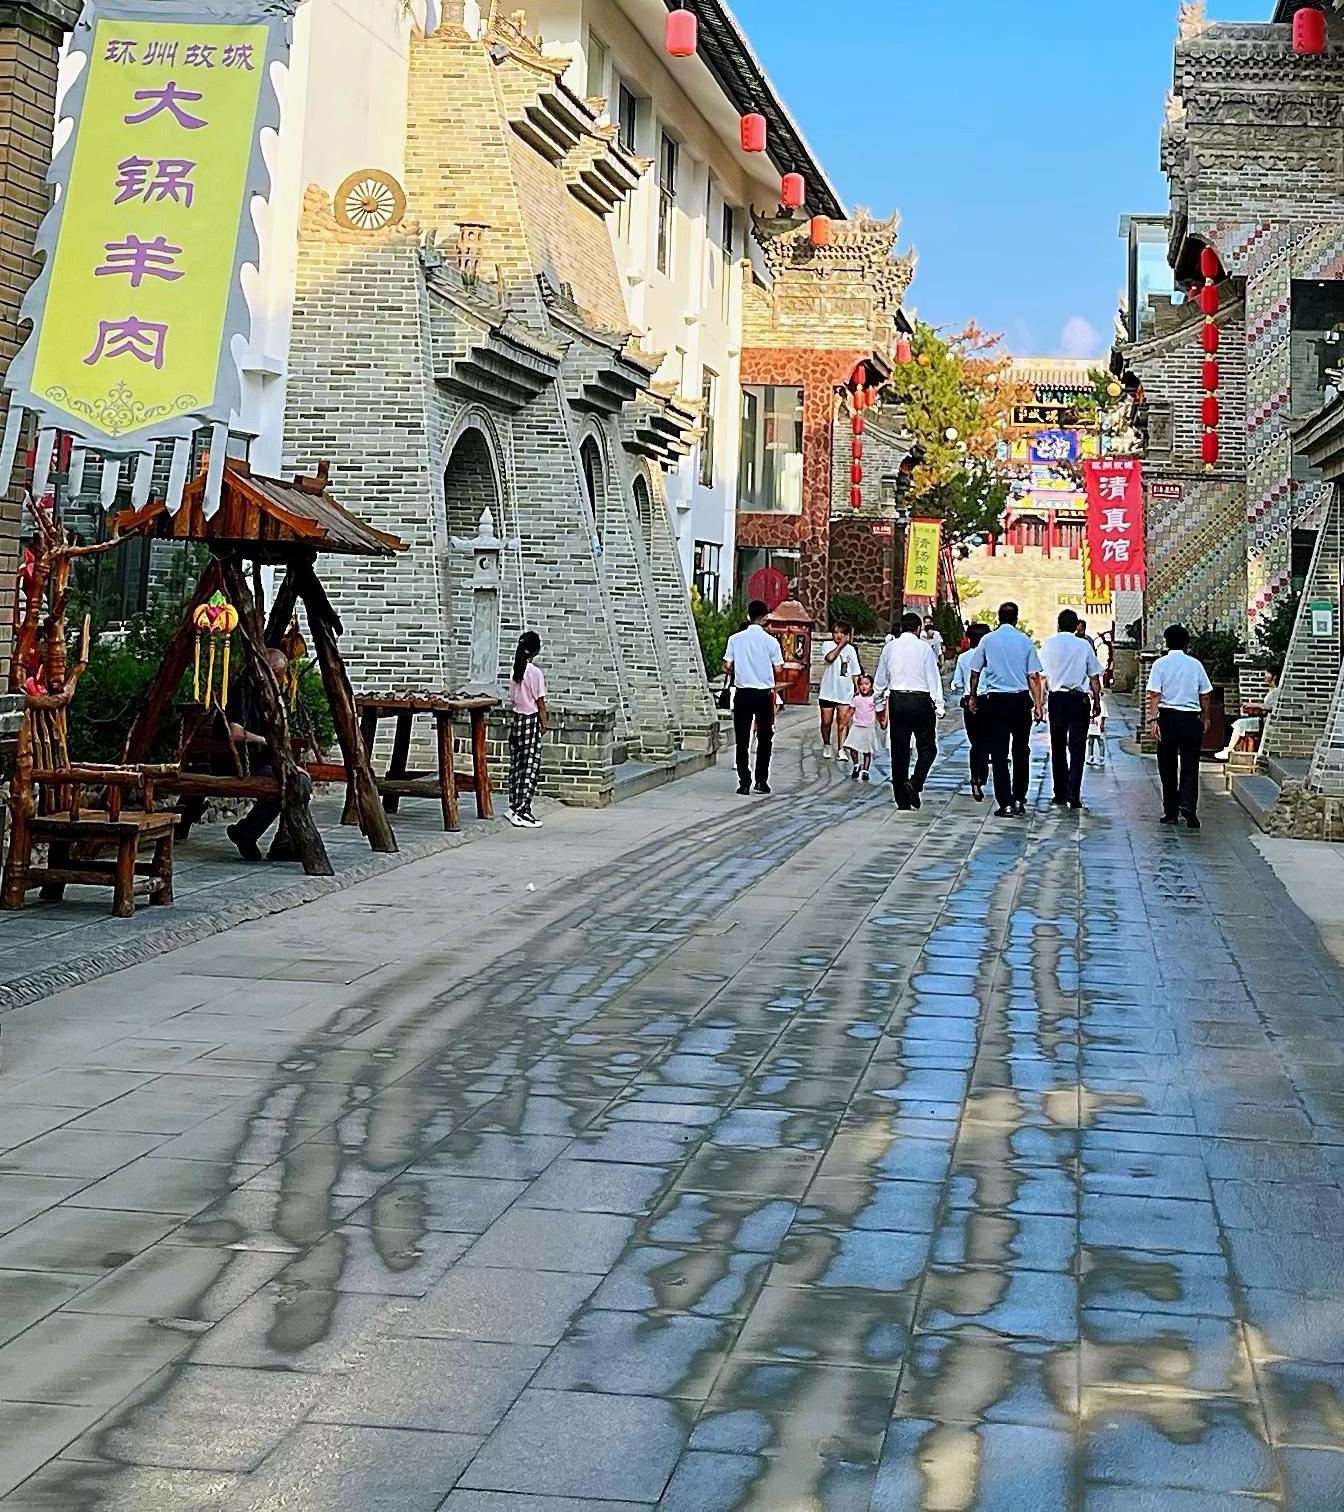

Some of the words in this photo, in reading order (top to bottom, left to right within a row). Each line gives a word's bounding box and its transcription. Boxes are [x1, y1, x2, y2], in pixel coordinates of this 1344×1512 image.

[104, 39, 255, 72] 环州故城
[83, 81, 209, 370] 大锅羊肉
[1099, 476, 1132, 563] 清真馆
